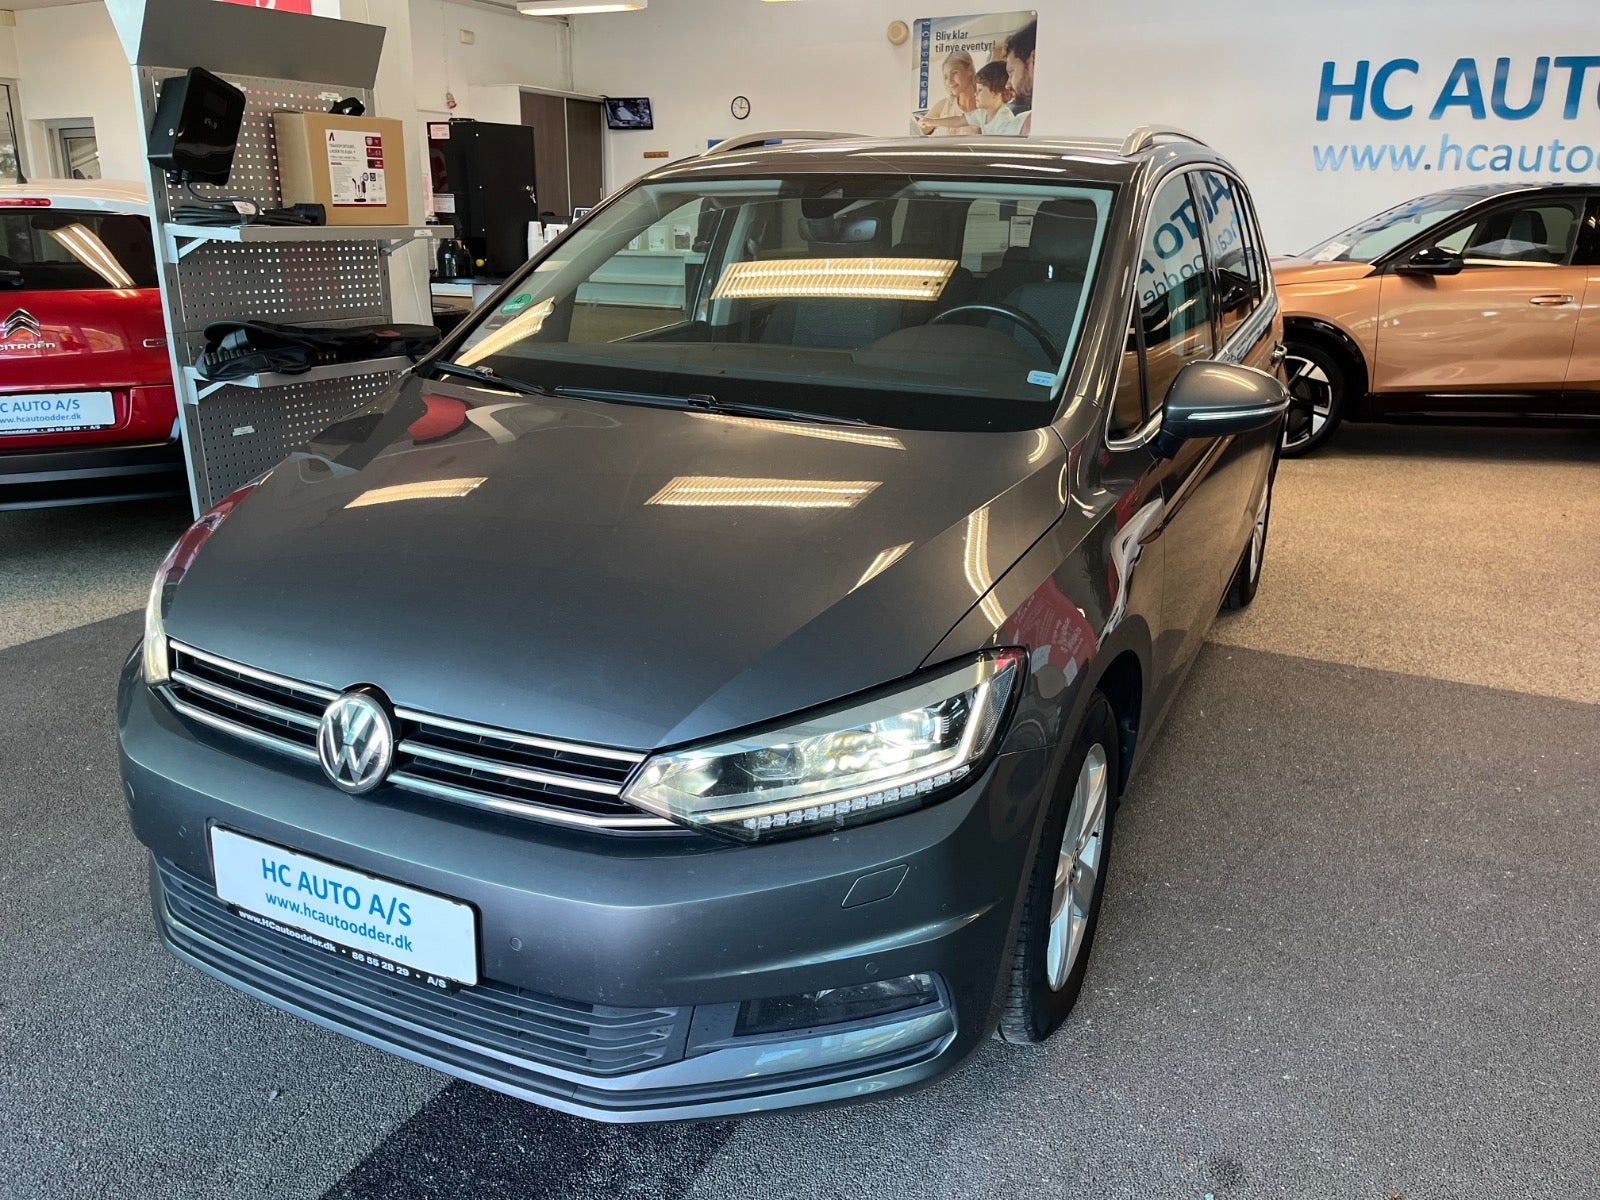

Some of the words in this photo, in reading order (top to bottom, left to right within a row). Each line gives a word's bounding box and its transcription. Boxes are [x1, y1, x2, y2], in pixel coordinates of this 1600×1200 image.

[935, 31, 951, 40] Bliv
[953, 29, 968, 39] klar
[935, 43, 943, 52] til
[945, 45, 959, 54] nye
[961, 39, 996, 52] eventyr!
[1316, 58, 1419, 121] HC
[1429, 56, 1600, 121] AUT
[1313, 133, 1600, 173] www.hcauto
[12, 400, 51, 412] AUTO
[56, 398, 80, 412] A/S
[261, 858, 292, 887] HC
[298, 871, 361, 910] AUTO
[368, 893, 412, 927] A/S
[265, 892, 413, 953] www.hcautoodder.dk
[238, 910, 337, 952] www.HCautoodder.dk
[366, 956, 380, 967] 55
[396, 966, 410, 977] 29
[426, 975, 447, 988] A/S
